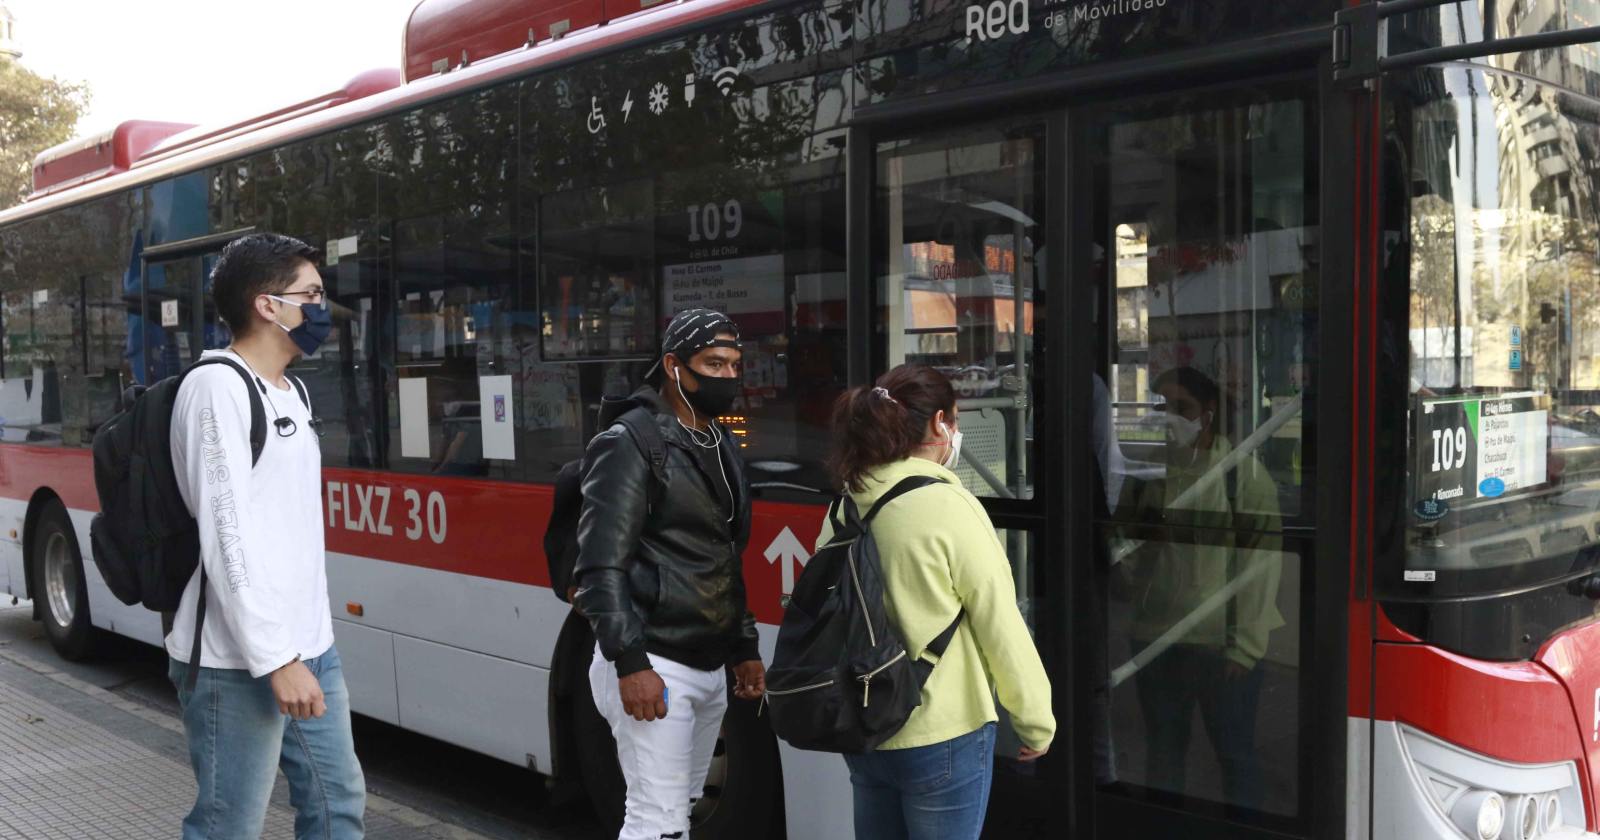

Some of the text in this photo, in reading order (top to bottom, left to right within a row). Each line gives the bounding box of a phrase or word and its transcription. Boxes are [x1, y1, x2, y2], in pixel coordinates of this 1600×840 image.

[966, 0, 1030, 44] Red
[1044, 11, 1065, 29] de
[687, 199, 743, 242] I09
[199, 407, 230, 485] STOP
[1431, 427, 1467, 472] I09
[326, 481, 447, 544] FLXZ 30
[1437, 484, 1464, 500] Rinconada
